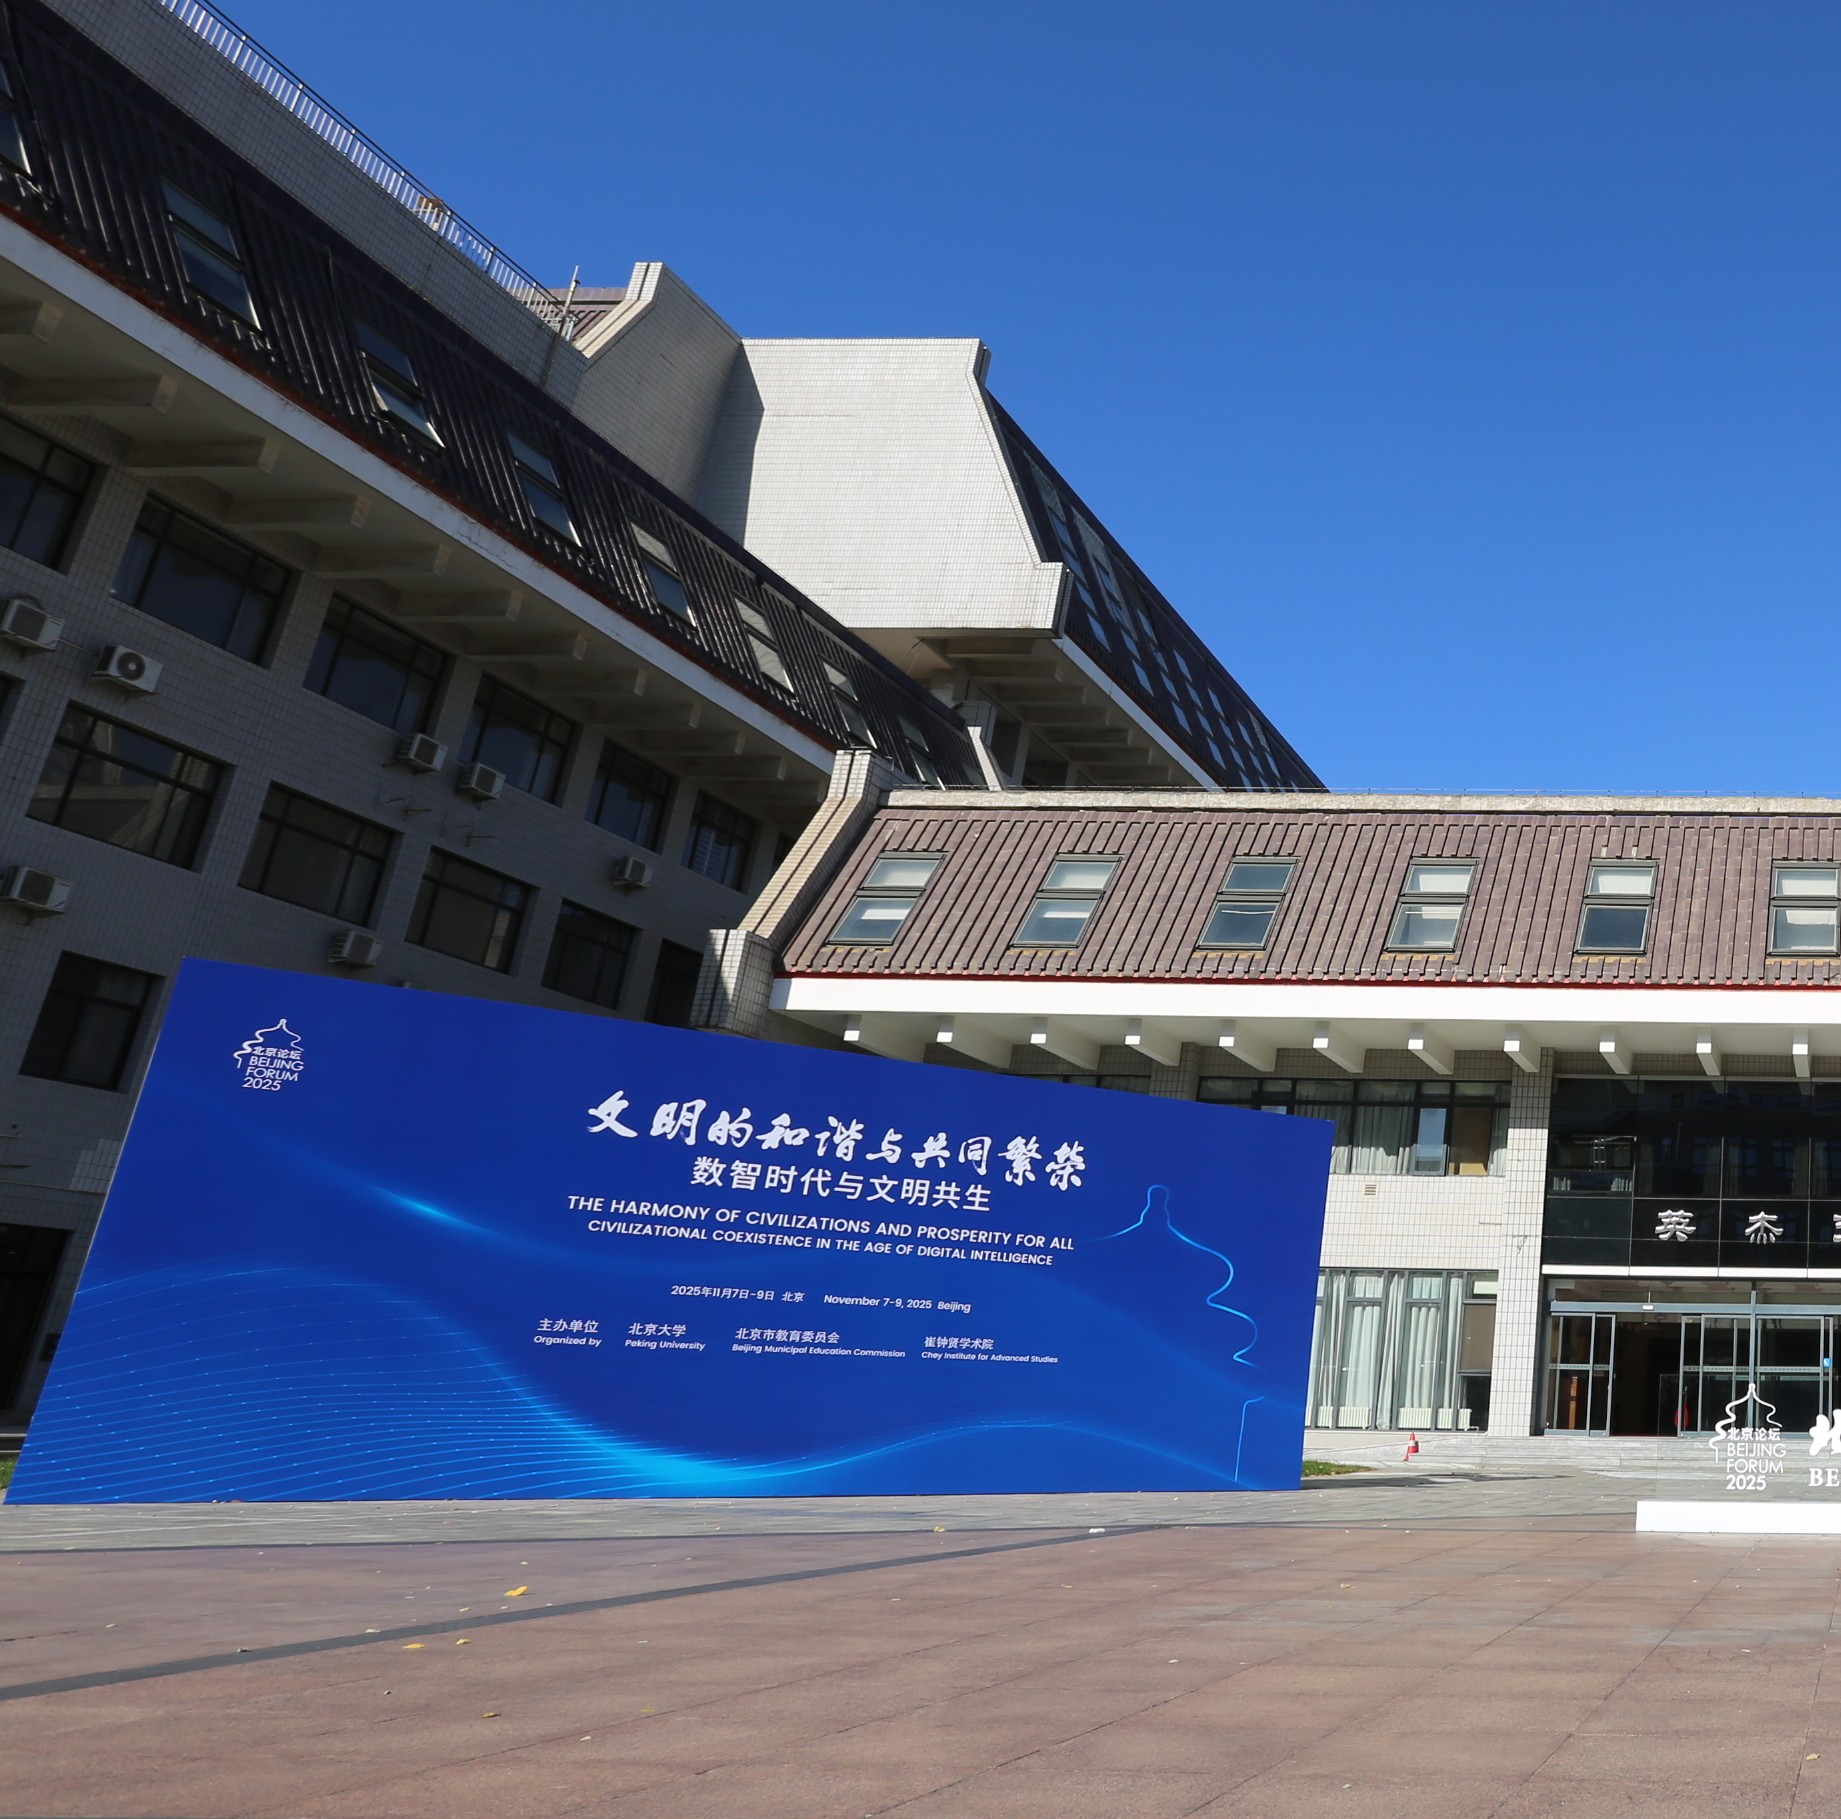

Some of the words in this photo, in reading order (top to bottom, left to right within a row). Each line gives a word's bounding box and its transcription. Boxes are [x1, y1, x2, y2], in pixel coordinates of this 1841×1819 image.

[251, 1046, 302, 1060] 北京论坛
[248, 1056, 304, 1071] BEIJING
[245, 1067, 299, 1082] FORUM
[242, 1077, 282, 1091] 2025
[587, 1090, 1086, 1191] 文明的和谐与共同繁荣
[690, 1156, 992, 1211] 数智时代与文明共生
[568, 1195, 605, 1212] THE
[609, 1199, 711, 1220] HARMONY
[715, 1208, 741, 1223] OF
[745, 1211, 871, 1234] CIVILIZATIONS
[875, 1222, 912, 1237] AND
[916, 1225, 1012, 1245] PROSPERITY
[1015, 1234, 1046, 1248] FOR
[1049, 1237, 1074, 1251] ALL
[588, 1220, 708, 1240] CIVILIZATIONAL
[712, 1230, 813, 1248] COEXISTENCE
[815, 1238, 831, 1249] IN
[835, 1239, 861, 1251] THE
[864, 1242, 893, 1254] AGE
[895, 1244, 914, 1255] OF
[917, 1245, 966, 1259] DIGITAL
[970, 1250, 1053, 1266] INTELLIGENCE
[670, 1285, 775, 1301] 2025年11月7日-9日
[781, 1291, 805, 1303] 北京
[823, 1294, 881, 1306] November
[883, 1297, 904, 1309] 7-9,
[906, 1299, 932, 1309] 2025
[937, 1301, 971, 1314] Beijing
[537, 1318, 599, 1333] 主办单位
[628, 1323, 686, 1337] 北京大学
[533, 1335, 587, 1346] Organized
[588, 1338, 602, 1347] by
[734, 1328, 840, 1344] 北京市教育委员会
[924, 1336, 994, 1350] 崔钟贤学术院
[624, 1339, 658, 1350] Peking
[659, 1341, 706, 1351] University
[731, 1344, 763, 1354] Beijing
[764, 1345, 808, 1355] Municipal
[808, 1346, 852, 1355] Education
[853, 1348, 906, 1357] Commission
[921, 1351, 943, 1361] Chey
[944, 1352, 976, 1360] Institute
[977, 1353, 989, 1361] for
[990, 1354, 1030, 1362] Advanced
[1030, 1355, 1059, 1363] Studies
[1726, 1427, 1781, 1441] 北京论坛
[1726, 1443, 1787, 1458] BEIJING
[1726, 1459, 1783, 1474] FORUM
[1726, 1475, 1767, 1491] 2025
